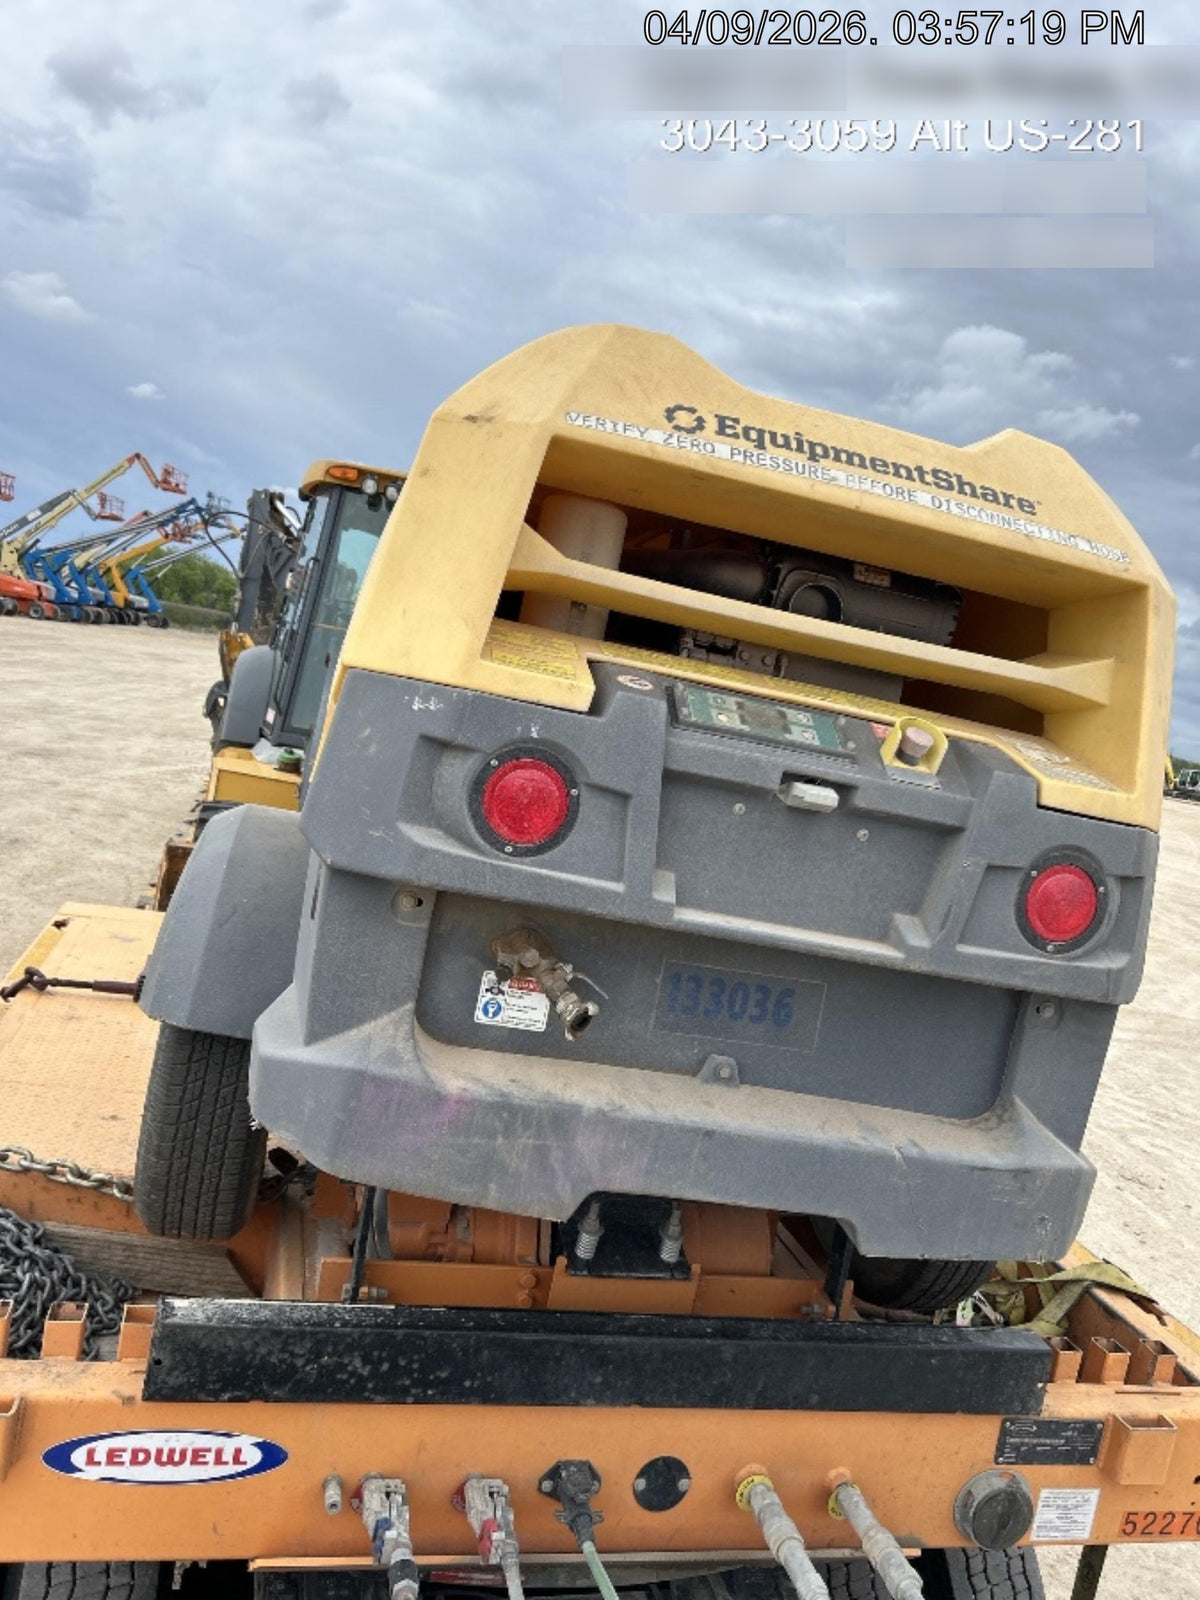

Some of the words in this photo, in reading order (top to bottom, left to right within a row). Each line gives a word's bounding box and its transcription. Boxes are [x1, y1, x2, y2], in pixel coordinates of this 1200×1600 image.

[566, 411, 649, 439] VERIFY
[662, 430, 717, 455] ZERO
[730, 446, 834, 483] PRESSURE
[713, 413, 1039, 516] EquipmentShare
[668, 970, 796, 1027] 133036
[84, 1446, 248, 1467] LEDWELL
